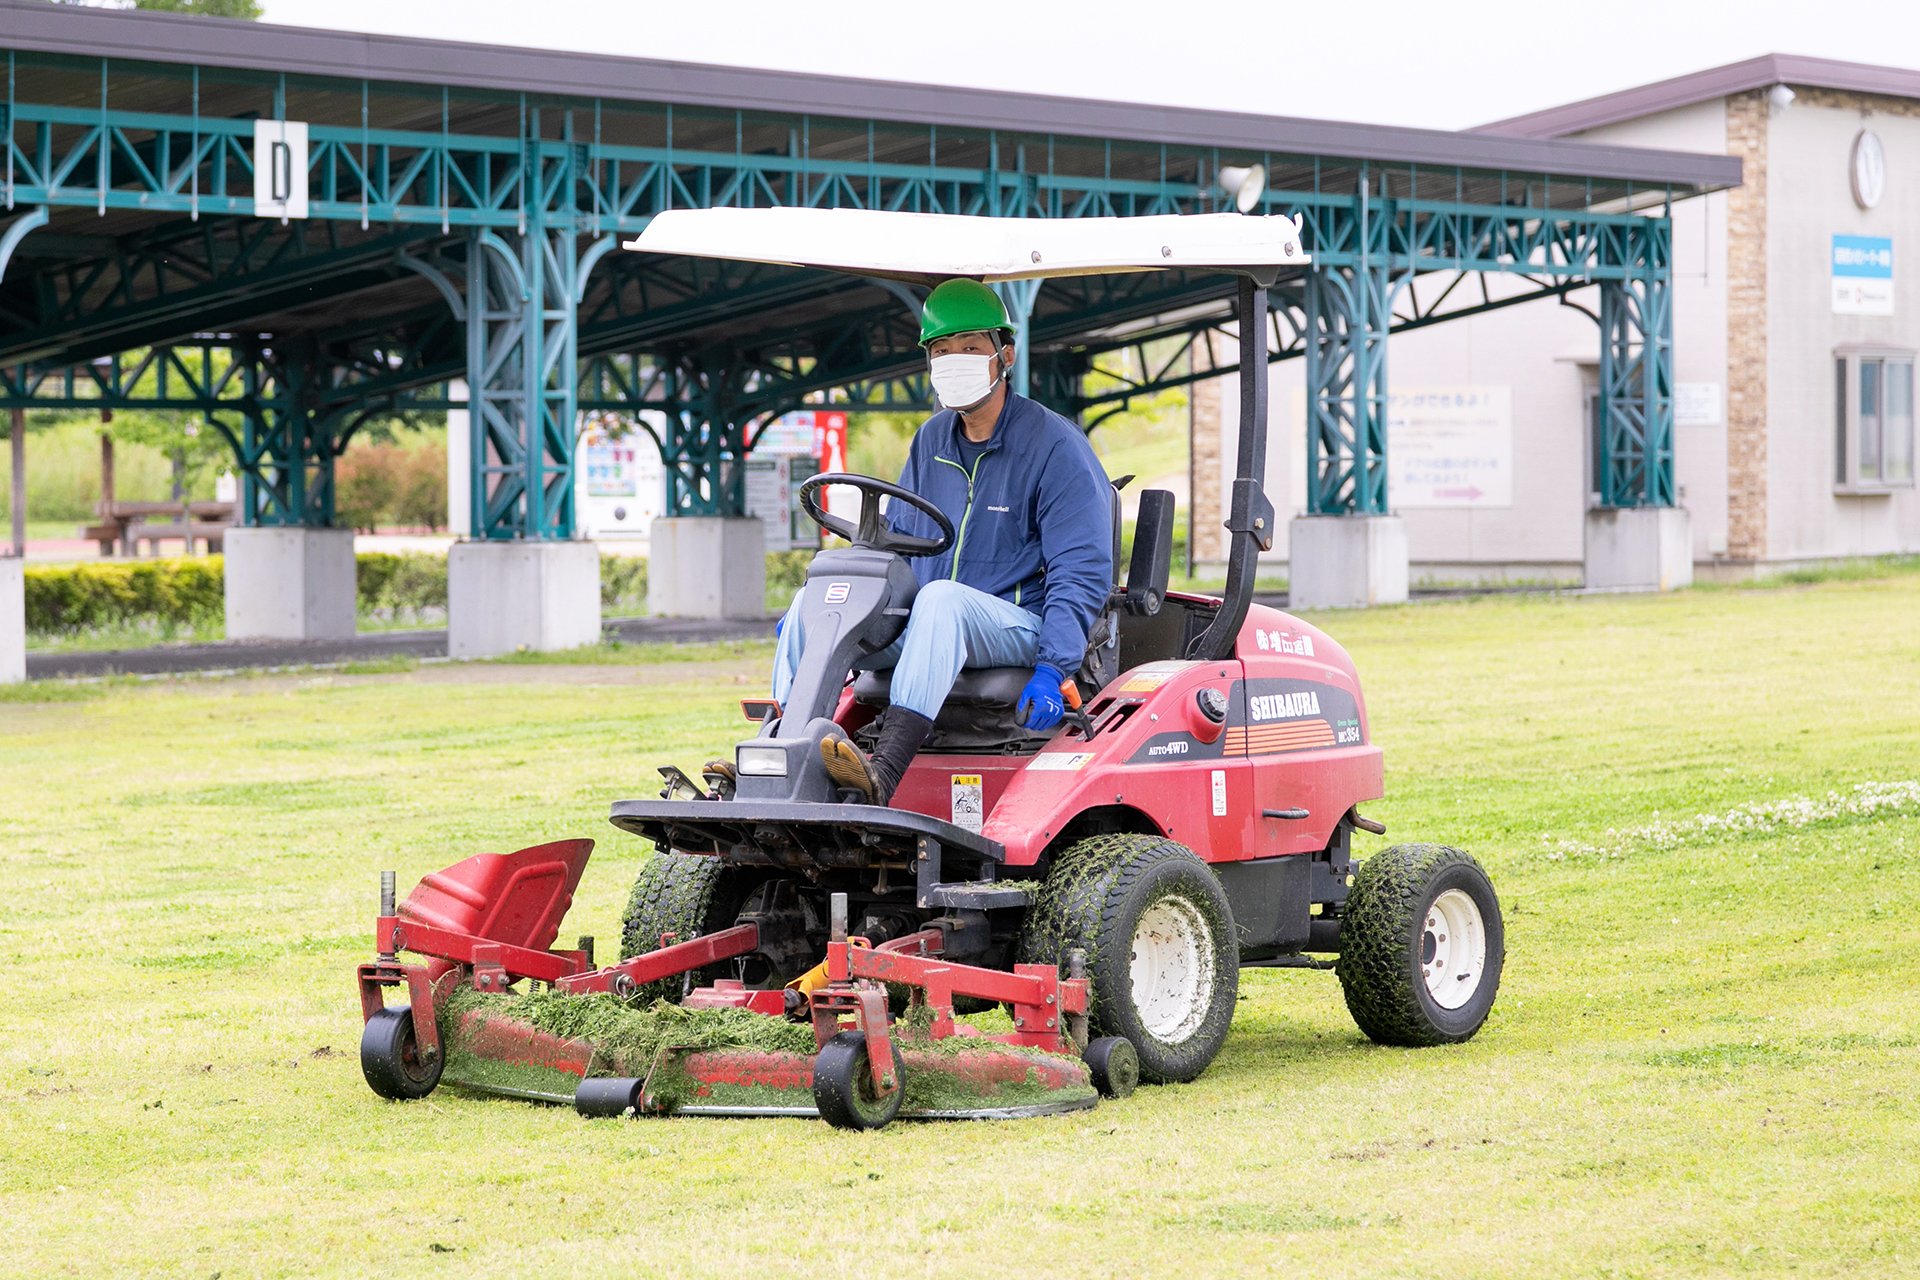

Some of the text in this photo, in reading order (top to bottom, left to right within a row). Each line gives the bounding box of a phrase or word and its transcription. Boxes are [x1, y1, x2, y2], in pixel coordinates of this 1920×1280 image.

[272, 142, 291, 200] D
[1250, 691, 1321, 721] SHIBAURA
[1338, 726, 1360, 743] MC354
[1148, 741, 1189, 756] AUTO4WD
